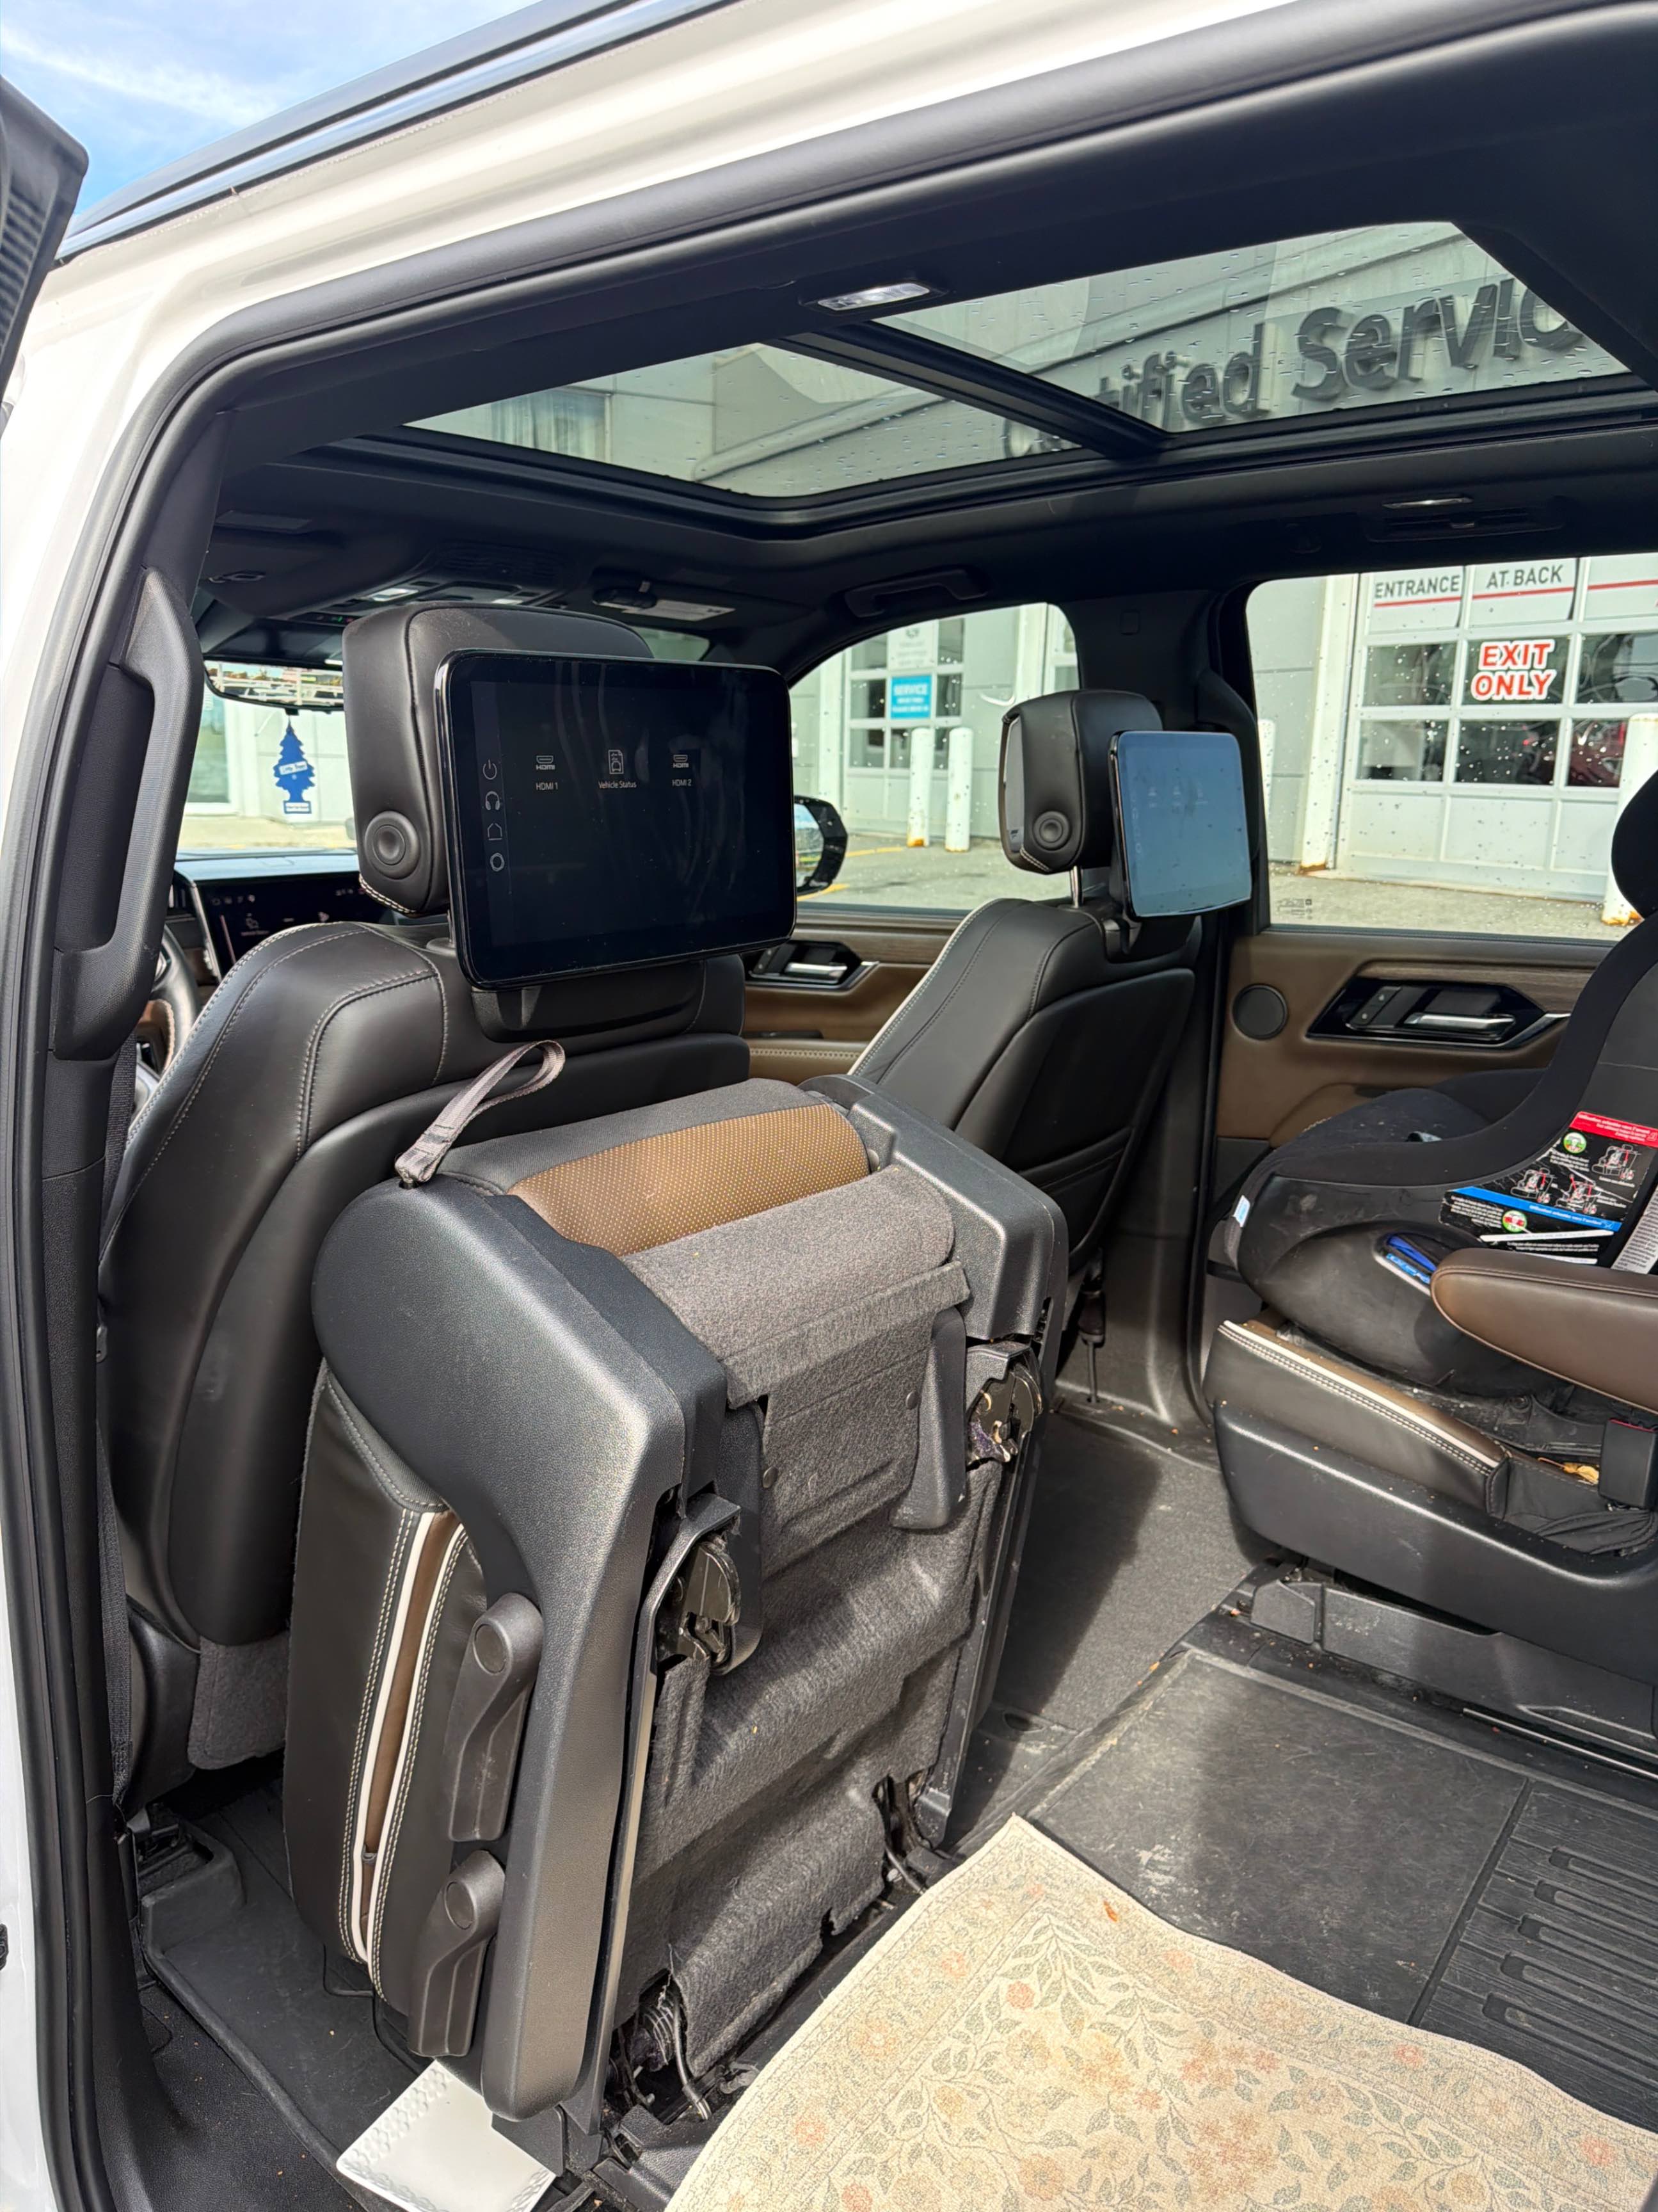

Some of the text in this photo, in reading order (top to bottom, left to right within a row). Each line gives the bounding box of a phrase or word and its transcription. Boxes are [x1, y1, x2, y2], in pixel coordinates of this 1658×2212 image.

[1291, 277, 1584, 402] Servic
[1375, 564, 1563, 598] ENTRANCE AT BACK
[1481, 642, 1552, 668] EXIT
[1474, 672, 1553, 698] ONLY
[536, 782, 554, 790] HDMI
[598, 780, 637, 789] Vehicle Status
